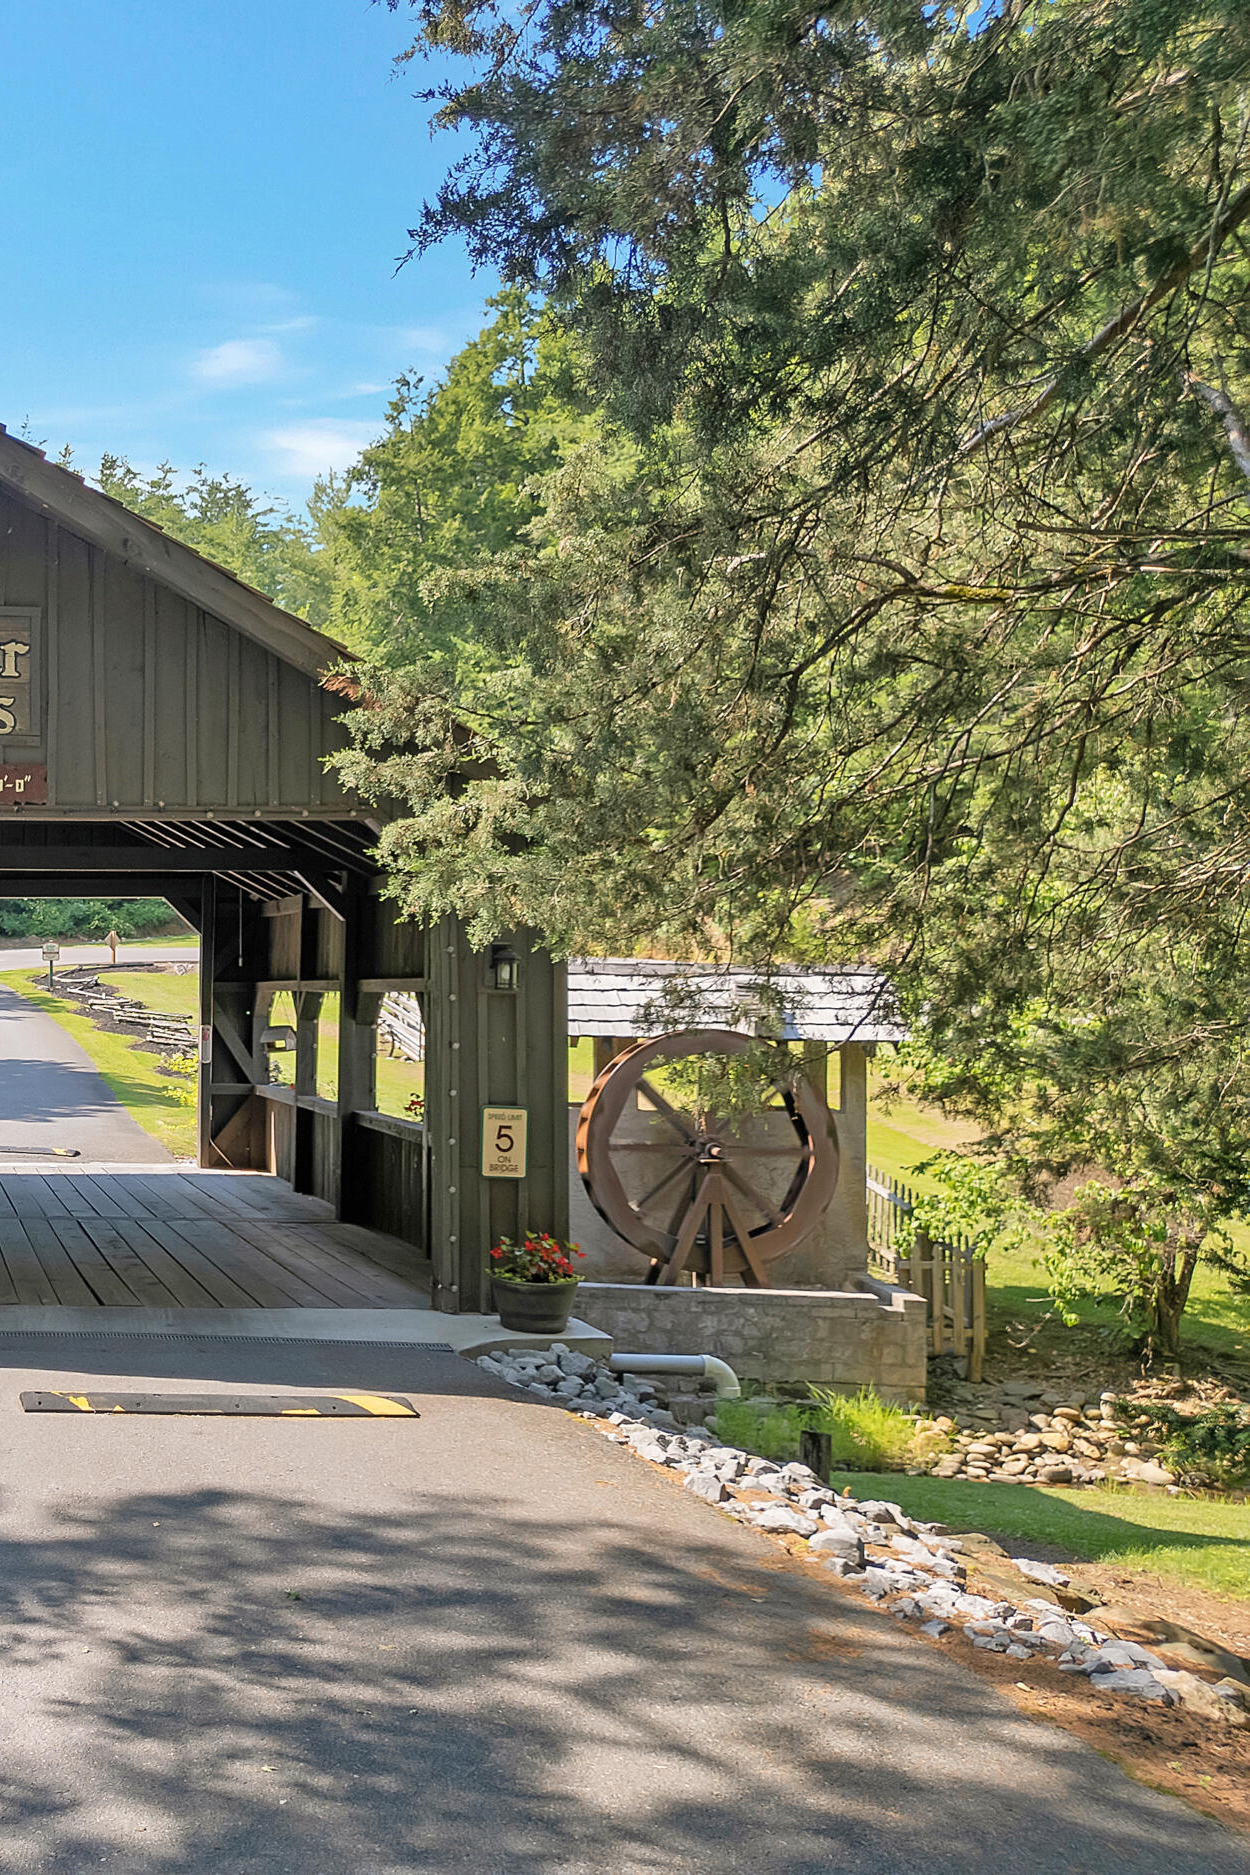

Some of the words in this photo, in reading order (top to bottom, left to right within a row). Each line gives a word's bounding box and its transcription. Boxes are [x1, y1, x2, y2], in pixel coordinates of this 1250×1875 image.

[495, 1125, 514, 1152] 5
[497, 1155, 511, 1163] ON
[489, 1164, 519, 1172] BRIDGE
